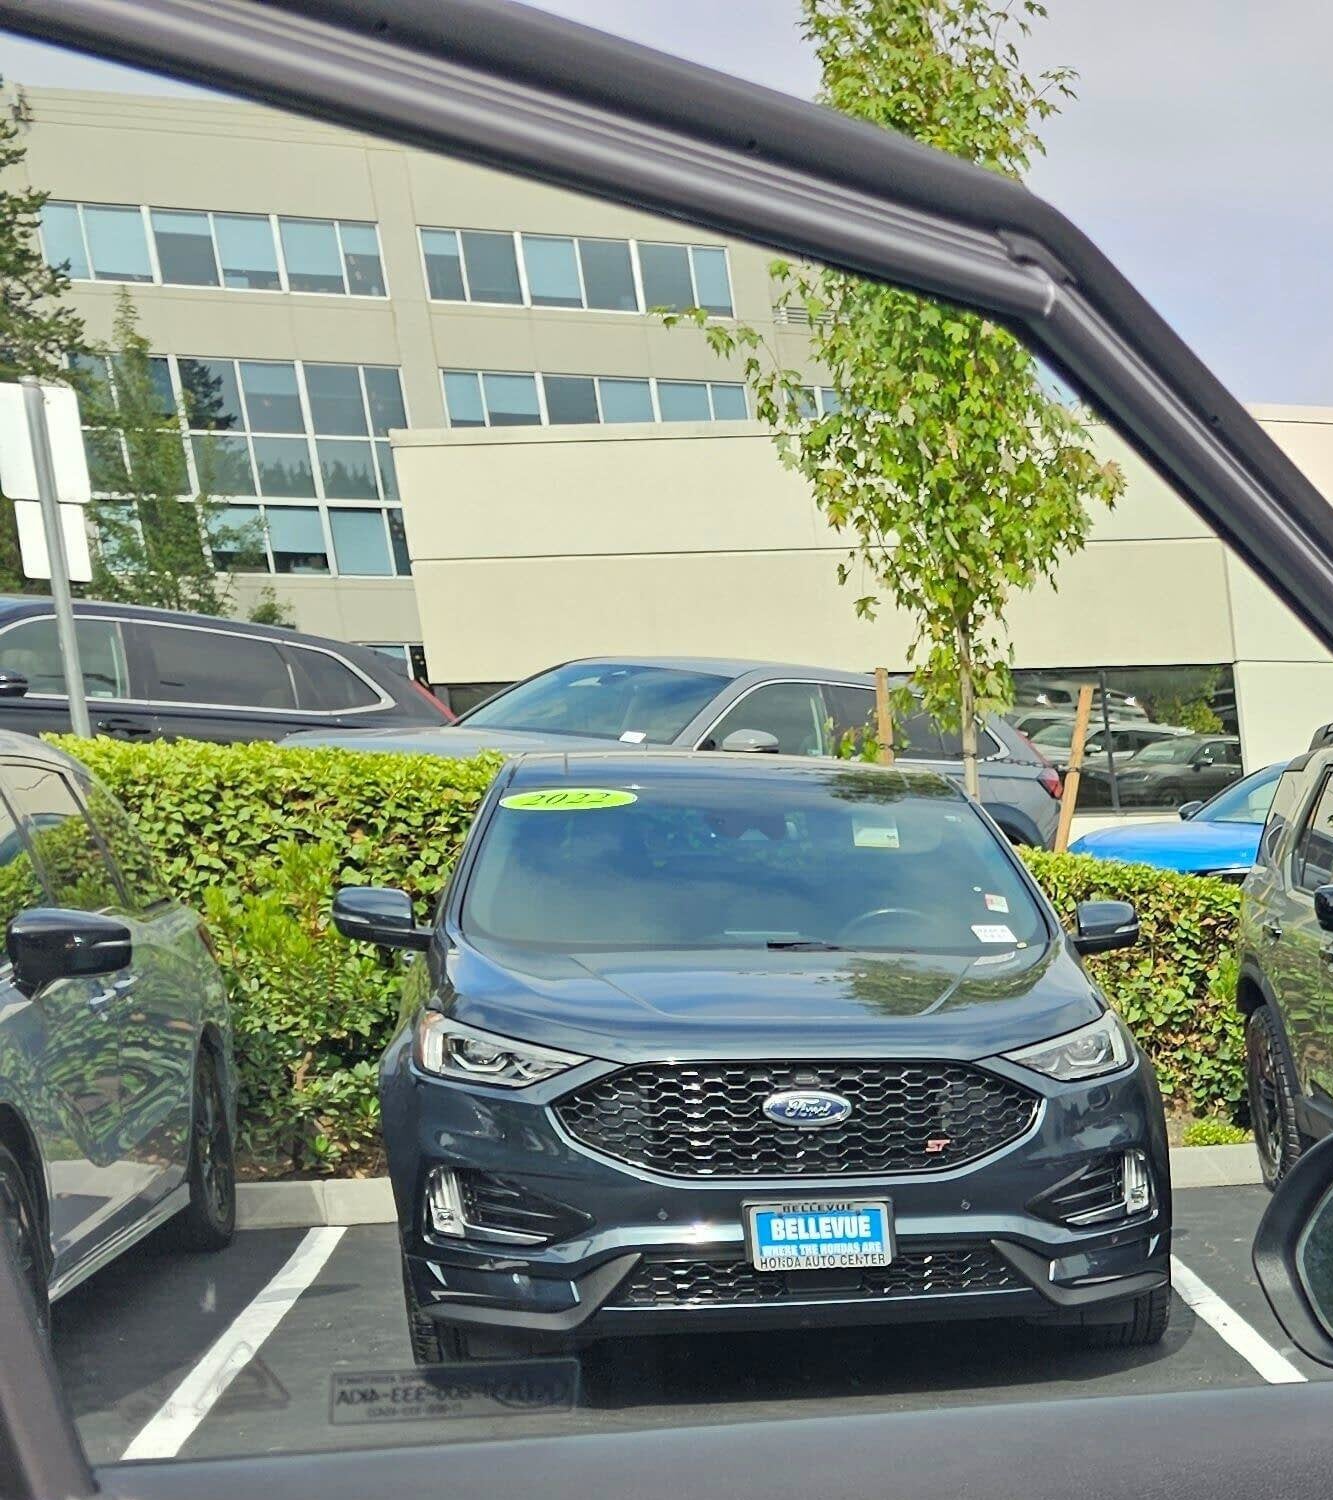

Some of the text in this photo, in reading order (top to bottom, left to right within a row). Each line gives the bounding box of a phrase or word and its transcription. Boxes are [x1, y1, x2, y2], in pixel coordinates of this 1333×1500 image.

[521, 792, 611, 807] 2022
[926, 1139, 951, 1152] ST
[770, 1215, 872, 1241] BELLEVUE
[800, 1244, 818, 1256] THE
[760, 1253, 886, 1269] HONDA AUTO CENTER
